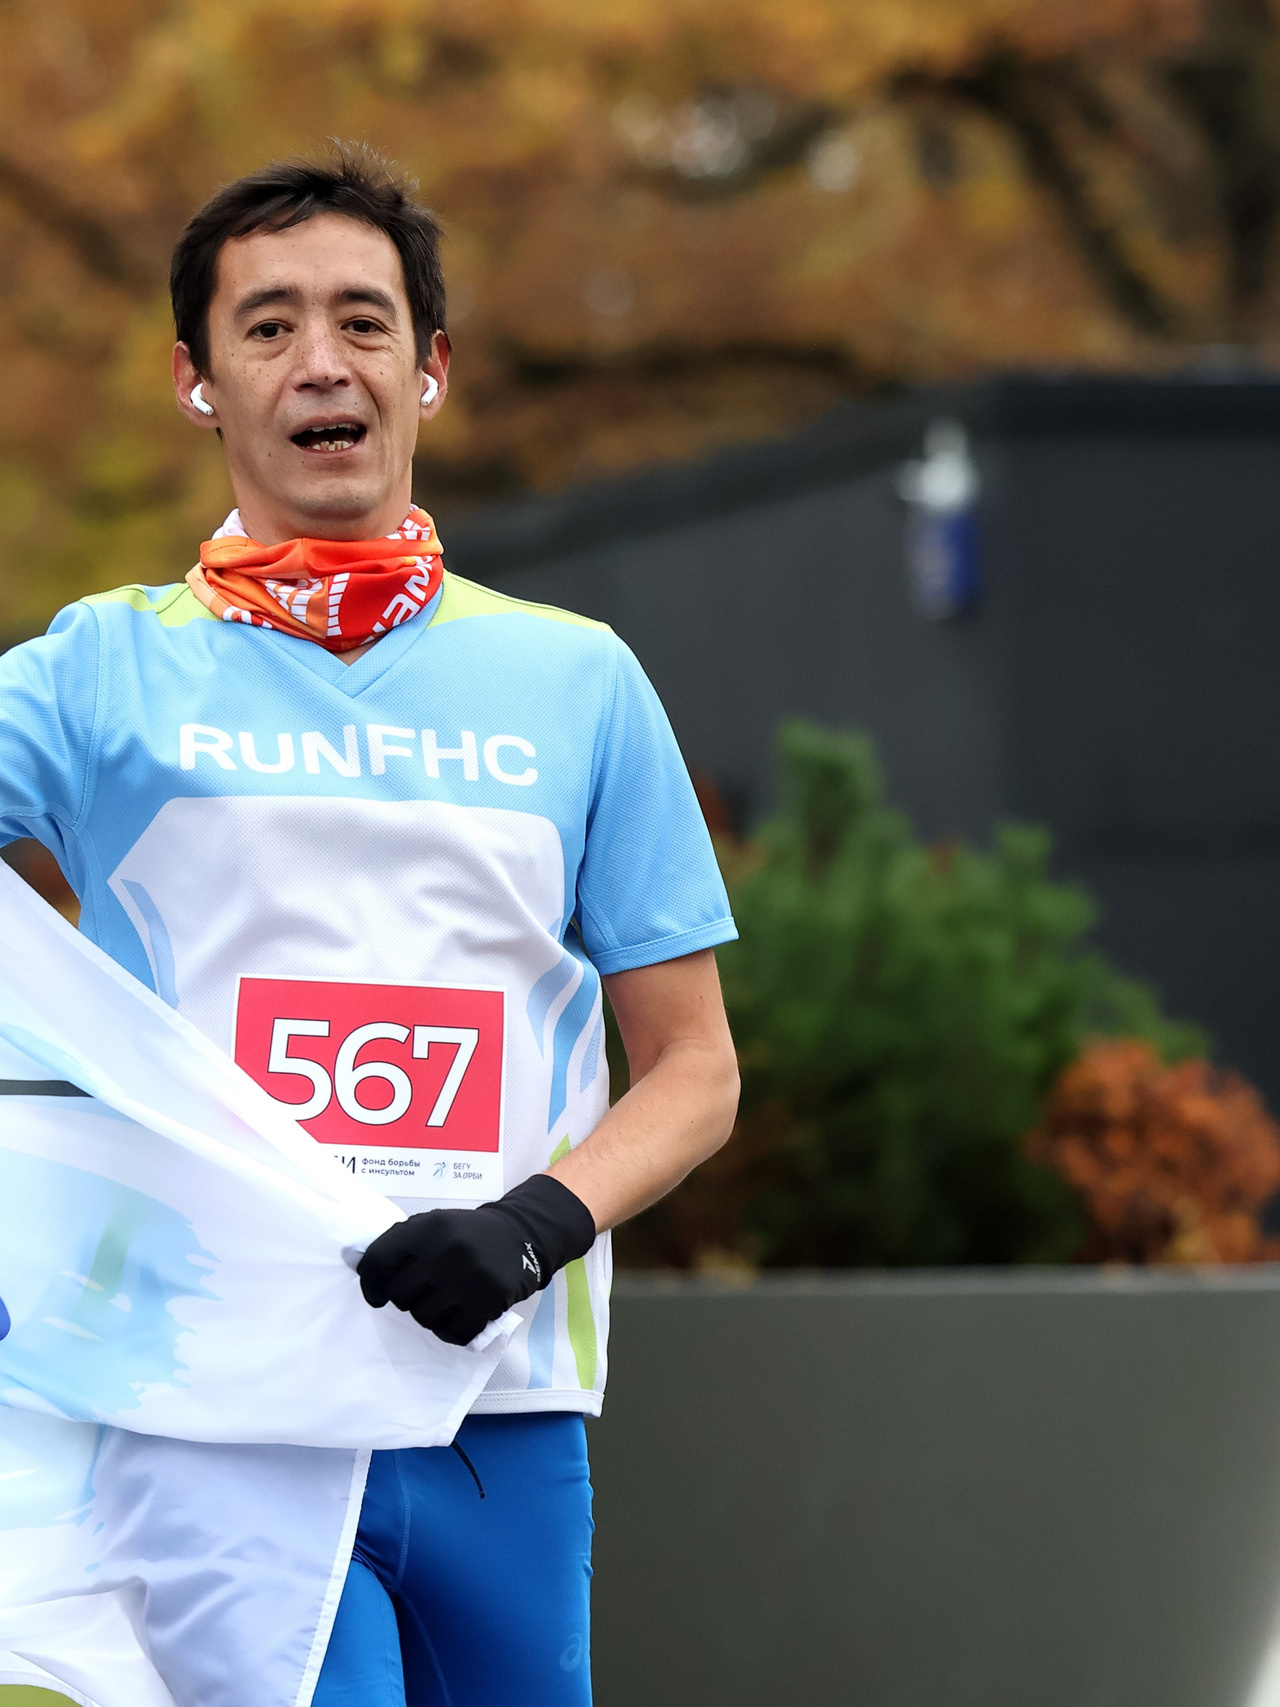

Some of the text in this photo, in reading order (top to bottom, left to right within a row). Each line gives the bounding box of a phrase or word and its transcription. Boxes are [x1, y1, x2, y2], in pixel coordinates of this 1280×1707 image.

[179, 722, 538, 787] RUNFHC
[267, 1017, 480, 1128] 567
[361, 1157, 386, 1167] фонд
[387, 1158, 421, 1168] борьбы
[453, 1162, 471, 1170] БЕГУ
[368, 1167, 415, 1177] инсультом
